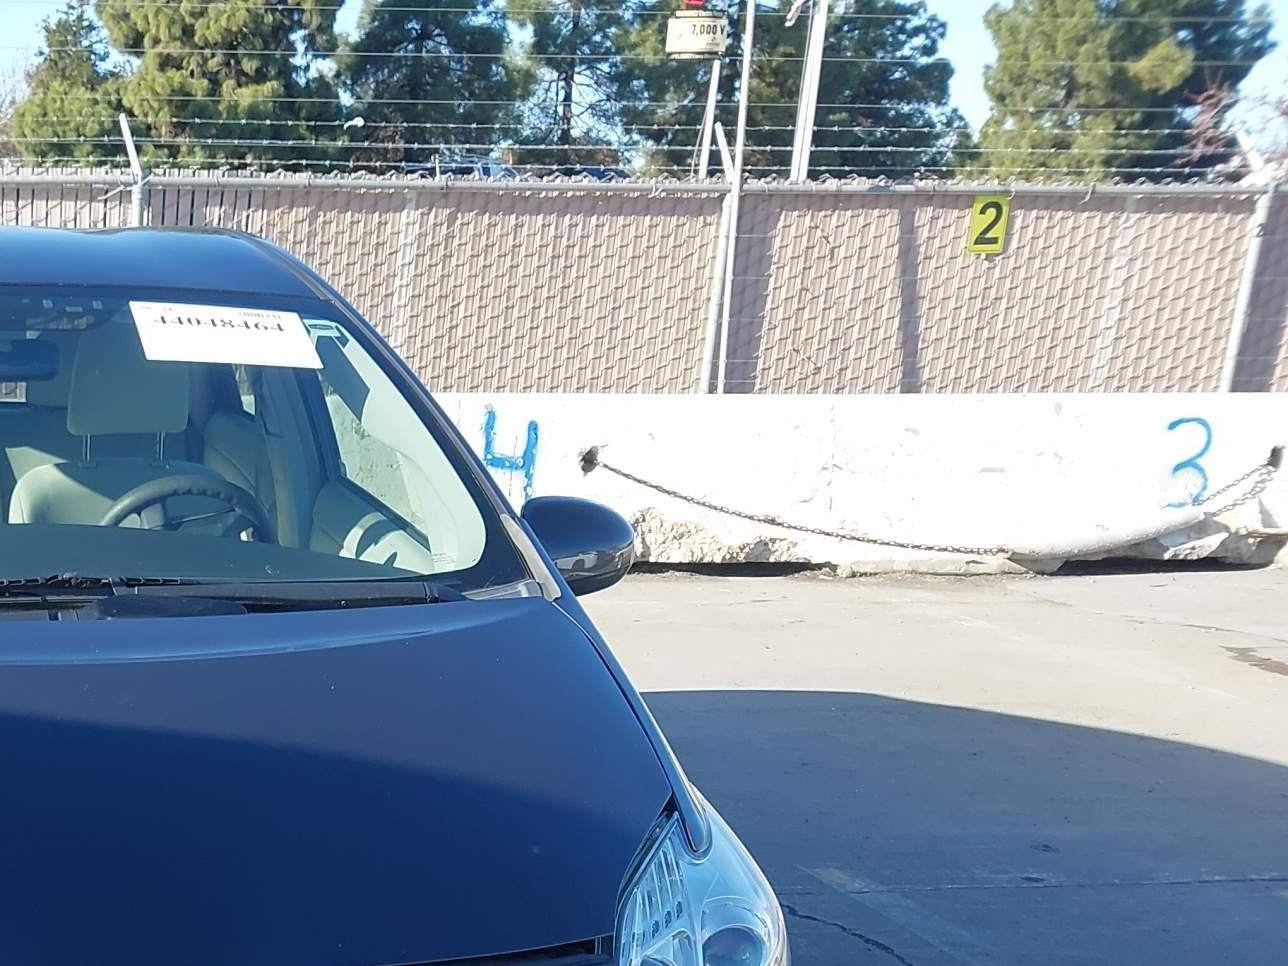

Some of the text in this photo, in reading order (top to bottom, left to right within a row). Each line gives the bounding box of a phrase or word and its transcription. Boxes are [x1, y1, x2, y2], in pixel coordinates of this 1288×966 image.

[691, 24, 718, 36] 7,000
[973, 201, 1003, 245] 2
[484, 409, 539, 501] 4
[1159, 417, 1212, 509] 3
